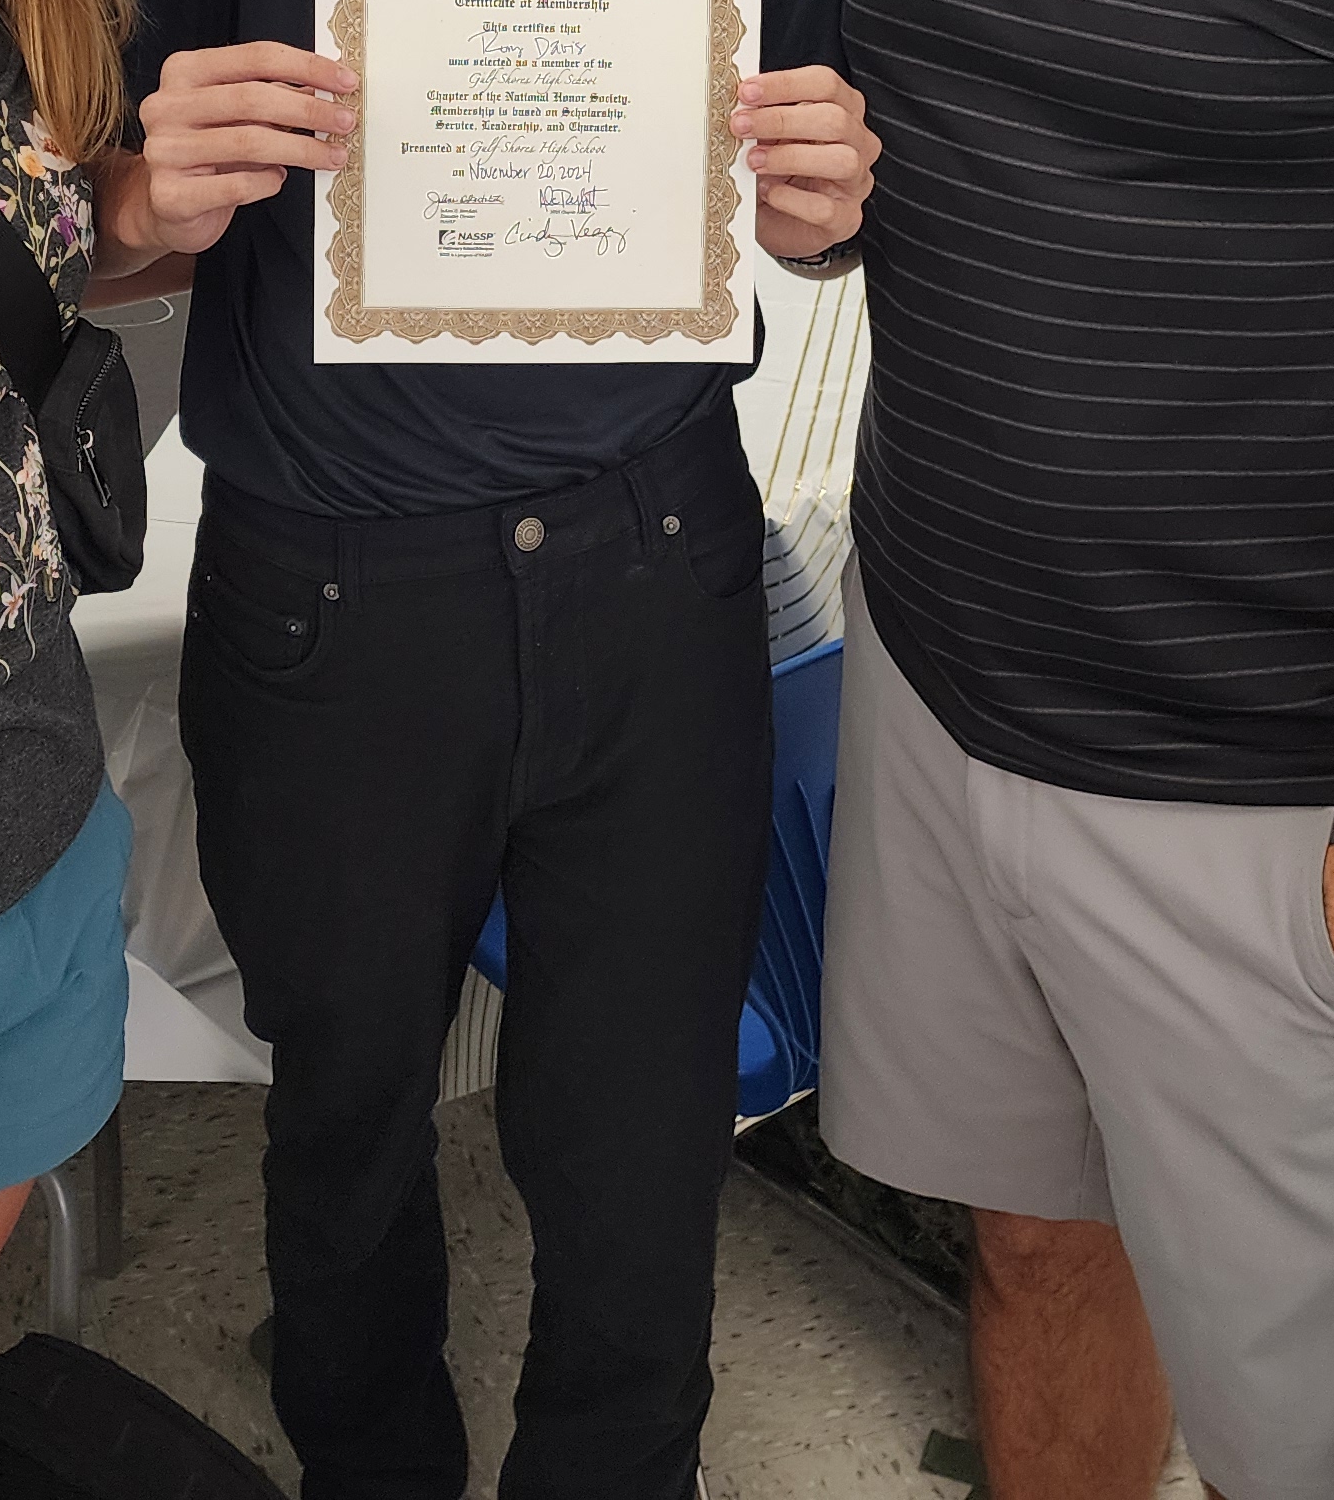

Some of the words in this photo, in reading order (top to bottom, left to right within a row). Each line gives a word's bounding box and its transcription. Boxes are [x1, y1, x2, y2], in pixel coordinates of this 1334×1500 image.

[482, 21, 508, 33] This
[512, 22, 556, 33] certifies
[560, 23, 581, 35] that
[534, 37, 587, 59] Davis
[449, 58, 470, 67] was
[473, 57, 512, 68] selected
[515, 58, 528, 68] as
[531, 58, 538, 68] a
[541, 58, 581, 69] member
[584, 58, 595, 69] of
[598, 59, 613, 70] the
[534, 68, 566, 95] High
[426, 91, 469, 106] Chapter
[472, 91, 484, 103] of
[486, 92, 501, 104] the
[505, 92, 549, 103] National
[552, 92, 586, 103] Honor
[589, 93, 631, 106] Society.
[430, 106, 495, 118] Membership
[498, 107, 508, 117] is
[512, 107, 542, 118] based
[545, 108, 558, 117] on
[561, 107, 627, 120] Scholarship,
[434, 120, 478, 132] Service,
[481, 121, 543, 134] Leadership,
[546, 121, 565, 132] and
[568, 121, 621, 133] Character.
[401, 142, 452, 155] Presented
[455, 143, 466, 154] at
[470, 135, 505, 165] Gulf
[539, 136, 574, 165] High
[571, 136, 606, 155] School
[452, 167, 465, 178] on
[469, 159, 531, 182] November
[458, 232, 495, 241] NASSP
